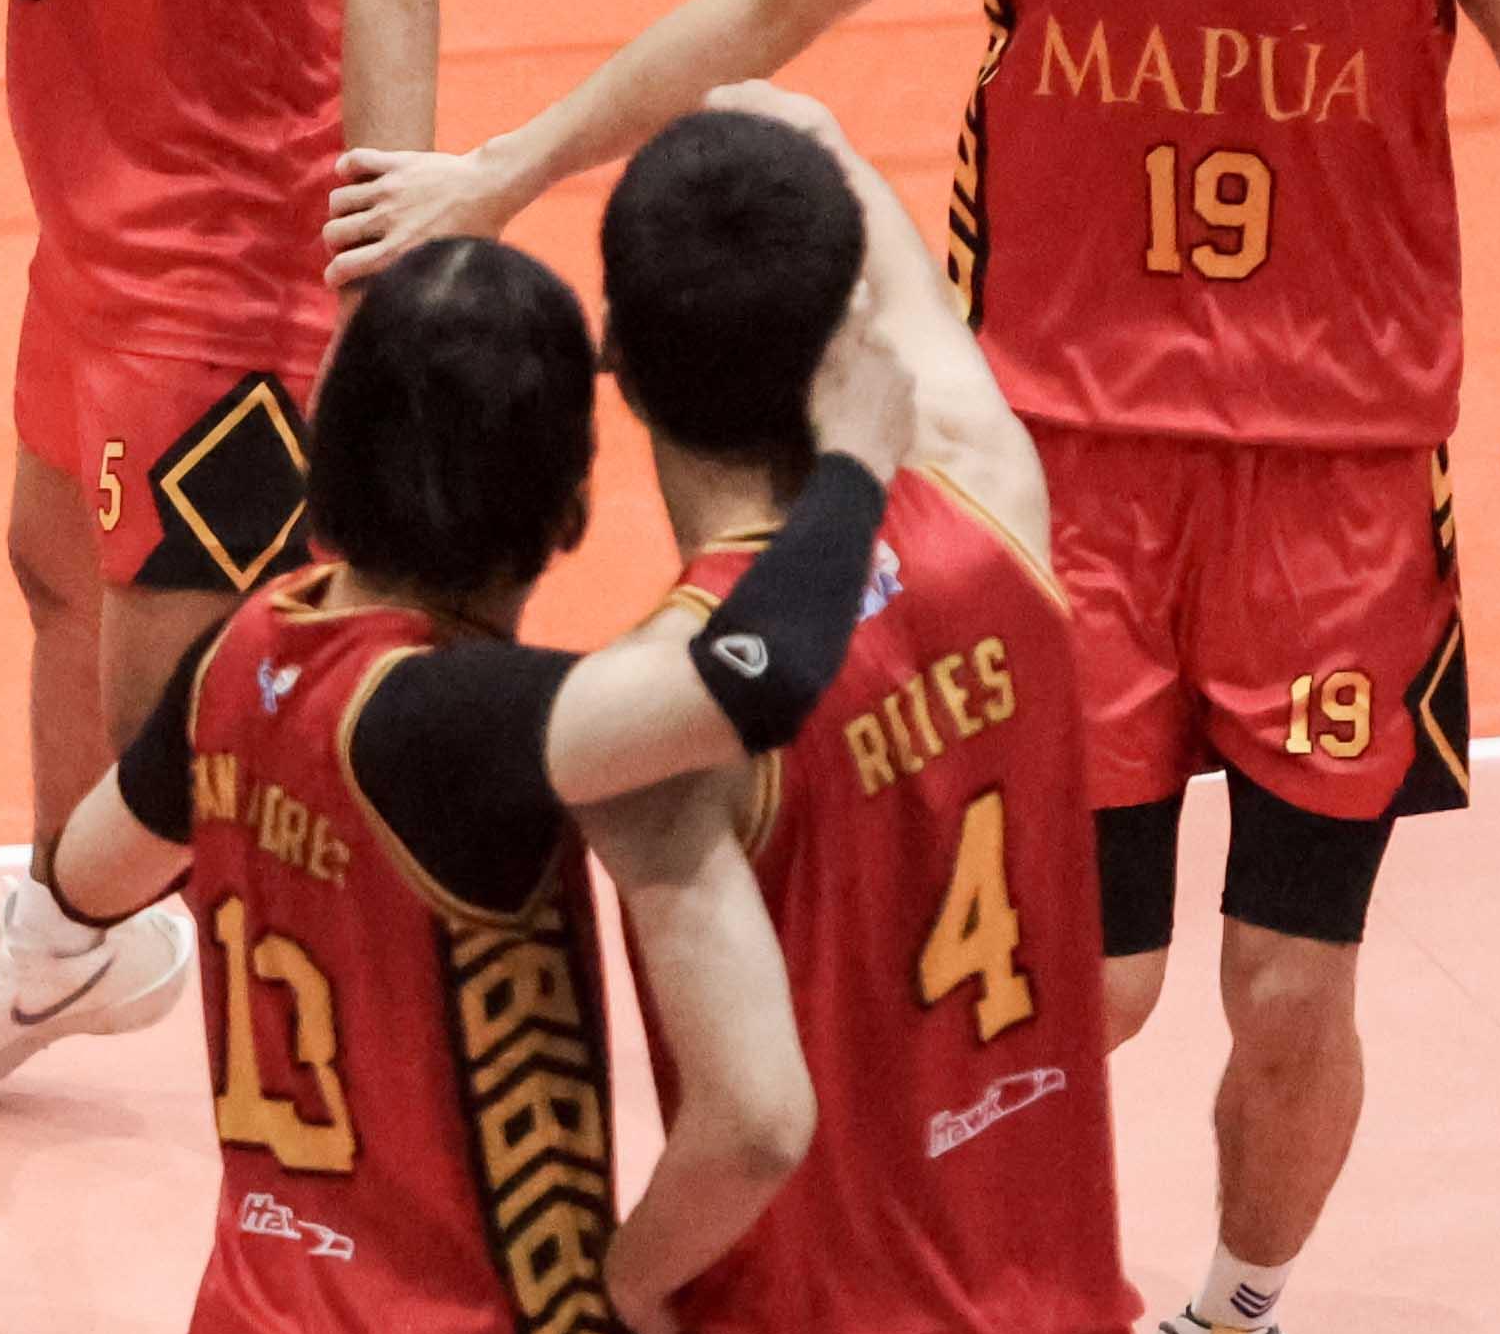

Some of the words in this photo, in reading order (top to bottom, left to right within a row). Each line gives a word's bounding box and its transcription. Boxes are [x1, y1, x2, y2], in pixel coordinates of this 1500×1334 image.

[1033, 14, 1374, 123] MAPÚA
[1144, 142, 1273, 280] 19
[98, 439, 125, 533] 5
[1284, 670, 1372, 759] 19
[919, 789, 1035, 1043] 4
